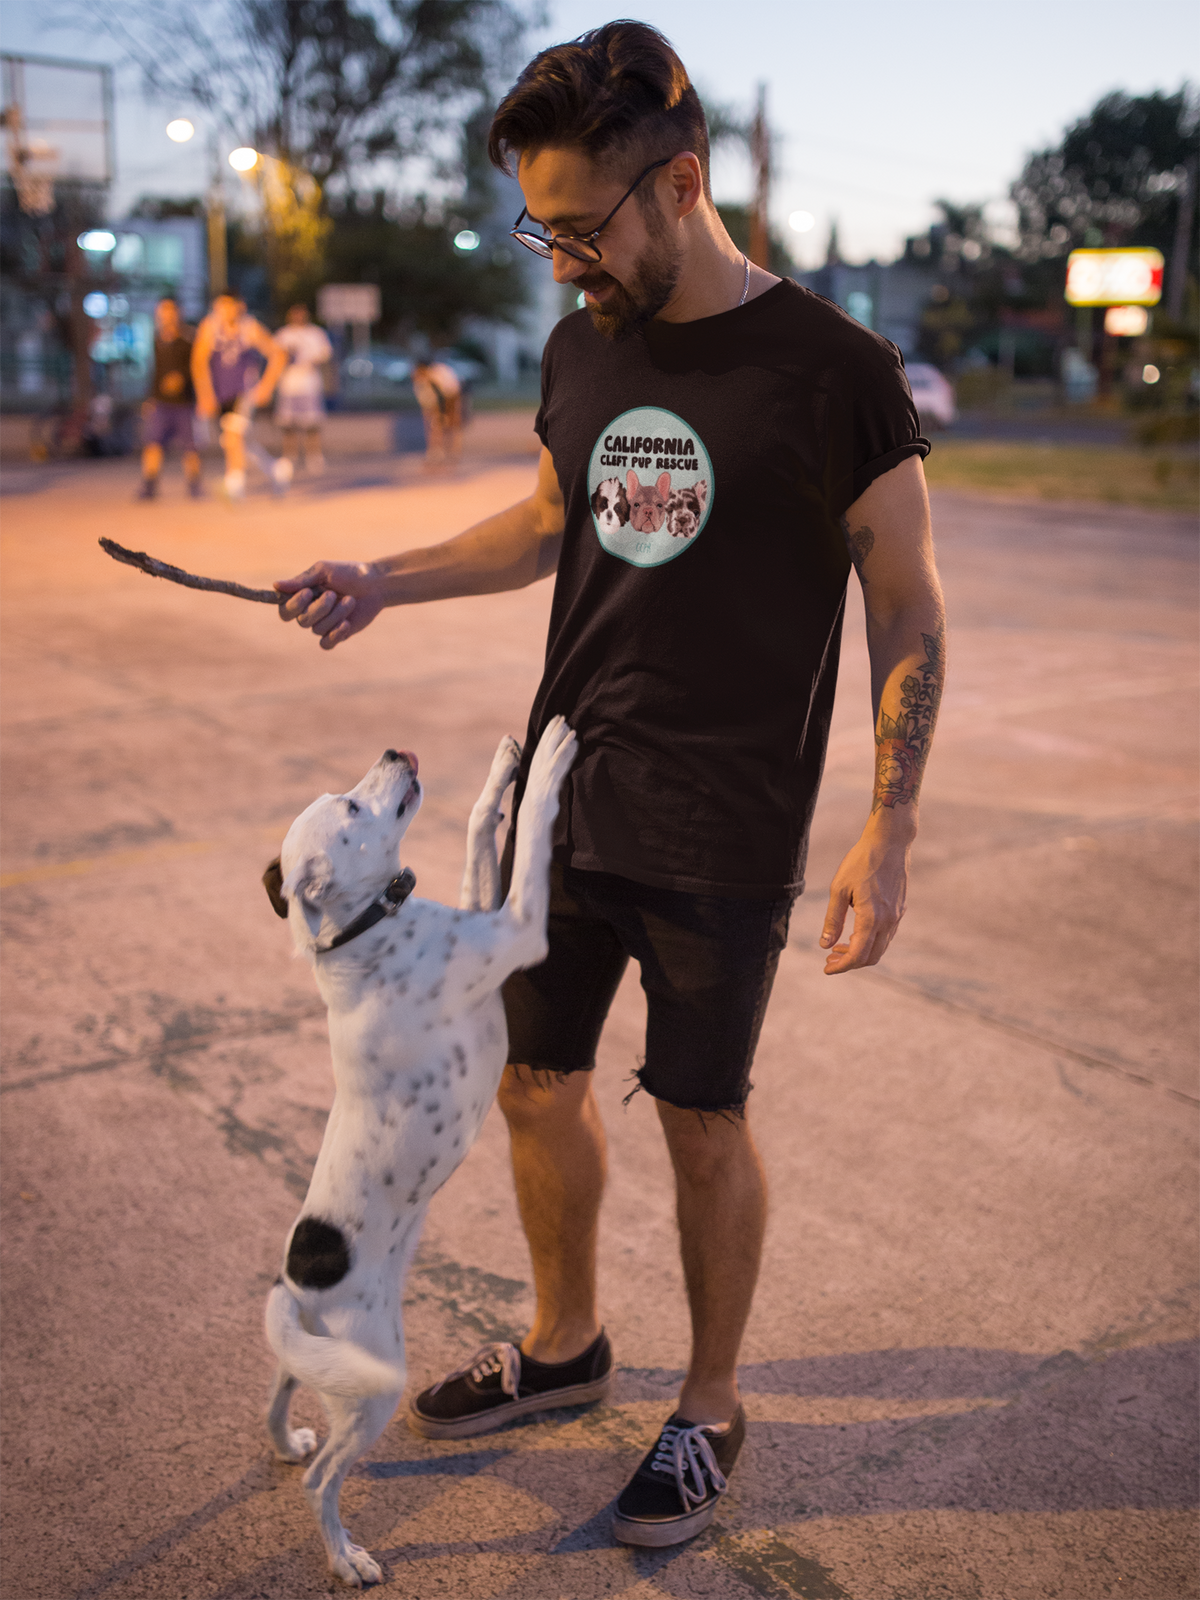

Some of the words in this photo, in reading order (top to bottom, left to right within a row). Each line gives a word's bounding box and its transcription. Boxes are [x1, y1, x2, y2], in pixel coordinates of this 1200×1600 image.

[604, 435, 695, 455] CALIFORNIA
[601, 455, 628, 467] CLEFT
[632, 457, 652, 469] PUP
[656, 458, 698, 471] RESCUE
